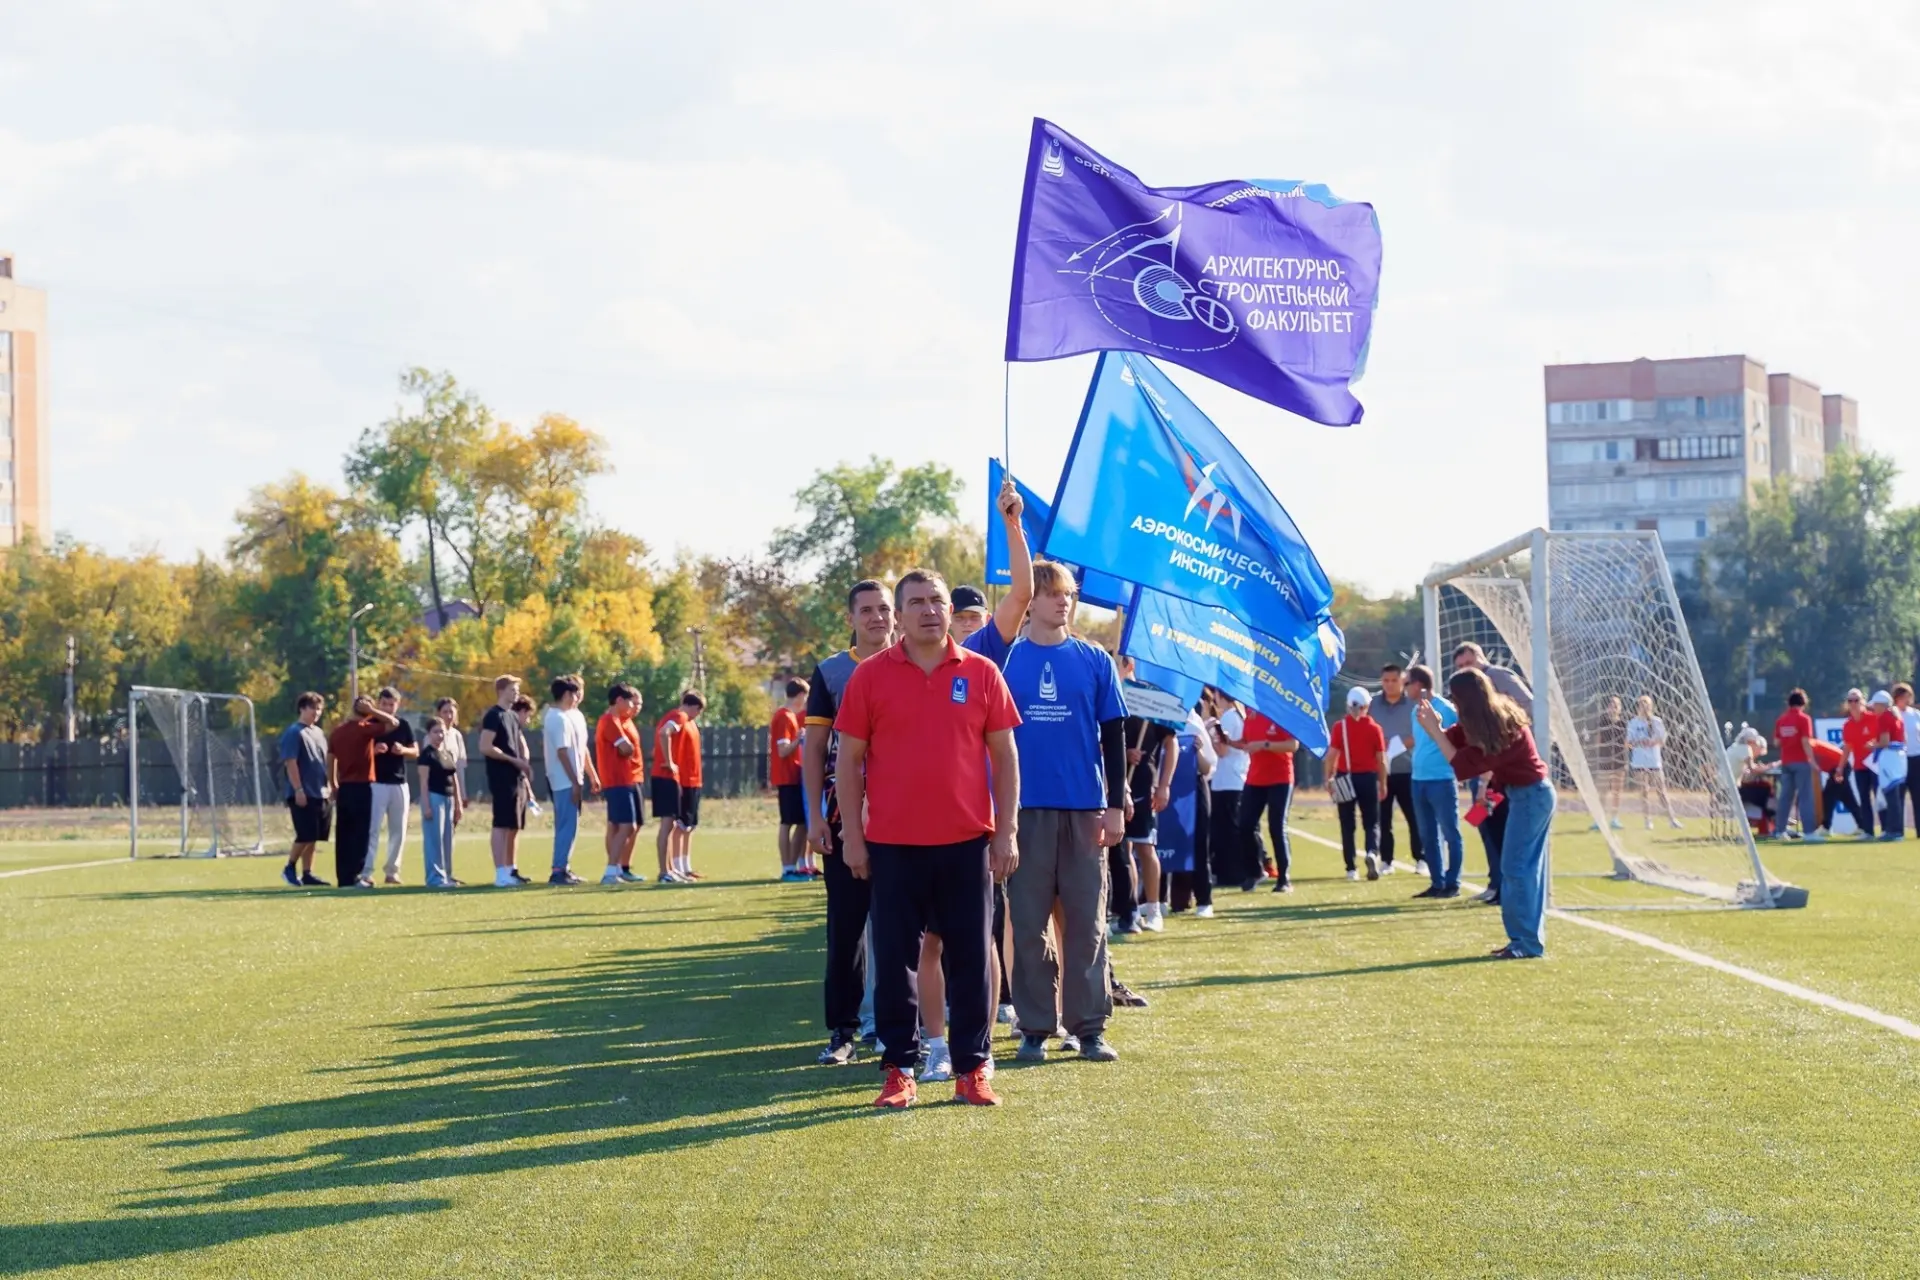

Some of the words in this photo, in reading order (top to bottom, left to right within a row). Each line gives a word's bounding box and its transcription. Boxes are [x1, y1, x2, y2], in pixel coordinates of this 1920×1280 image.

[1201, 255, 1345, 280] АРХИТЕКТУРНО-
[1198, 279, 1349, 306] СТРОИТЕЛЬНЫЙ
[1246, 308, 1354, 333] ФАКУЛЬТЕТ
[1130, 515, 1291, 601] АЭРОКОСМИЧЕСКИЙ
[1169, 549, 1245, 590] ИНСТИТУТ
